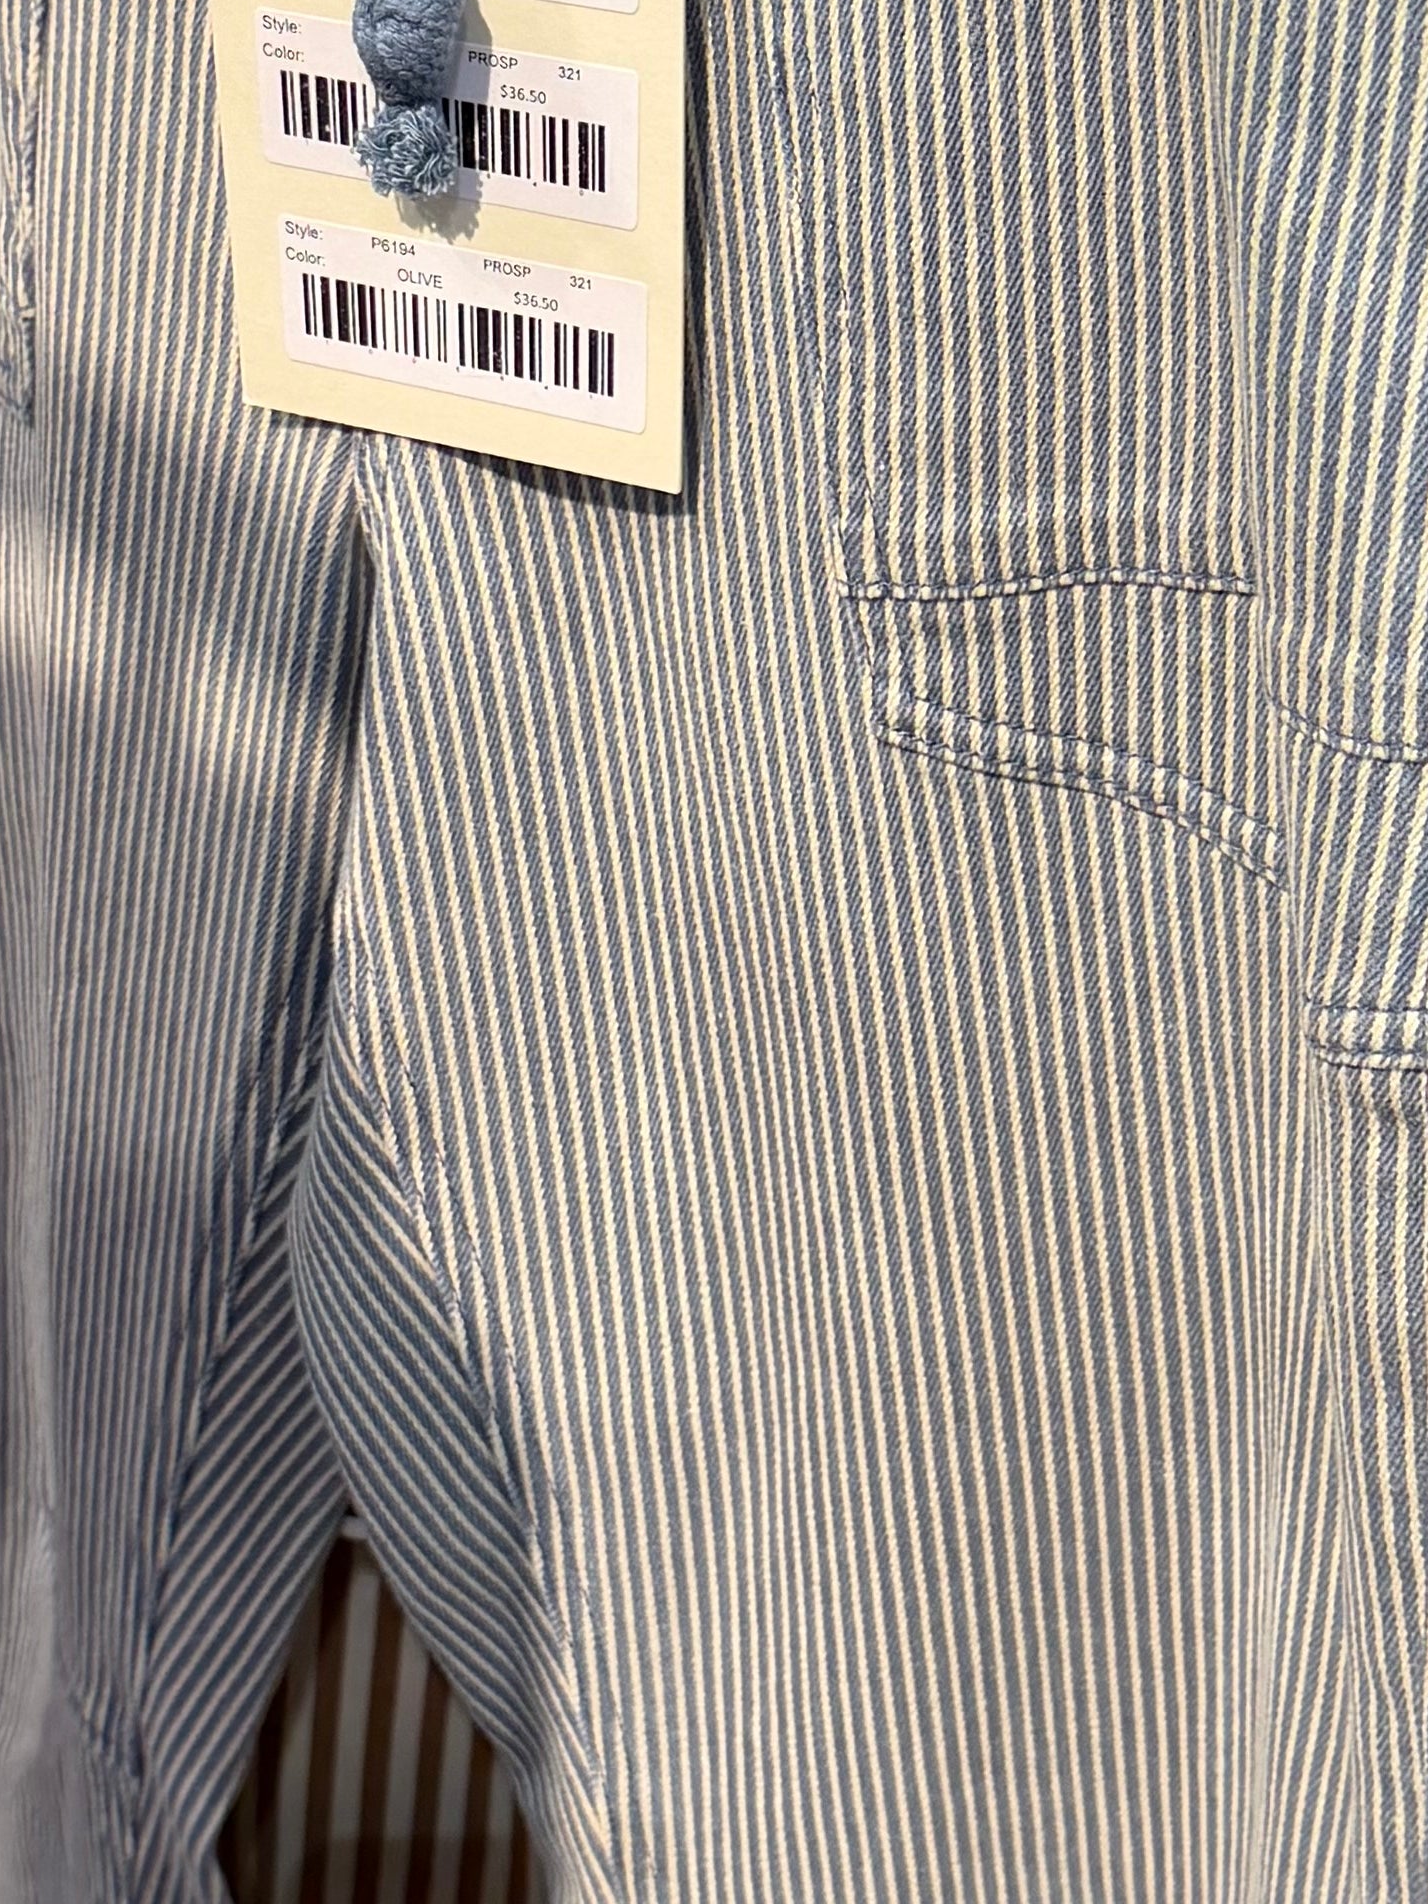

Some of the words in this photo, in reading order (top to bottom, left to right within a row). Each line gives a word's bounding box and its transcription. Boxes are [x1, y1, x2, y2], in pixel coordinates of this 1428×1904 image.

[262, 14, 302, 34] Style:
[262, 42, 304, 62] Color:
[468, 50, 518, 70] PROSP
[558, 66, 581, 81] 321
[500, 84, 547, 104] $36.50
[285, 220, 323, 240] Style:
[371, 236, 416, 256] P6194
[483, 258, 531, 278] PROSP
[569, 275, 592, 290] 321
[285, 246, 325, 266] Color:
[397, 268, 444, 289] OLIVE
[513, 291, 559, 312] $36.50
